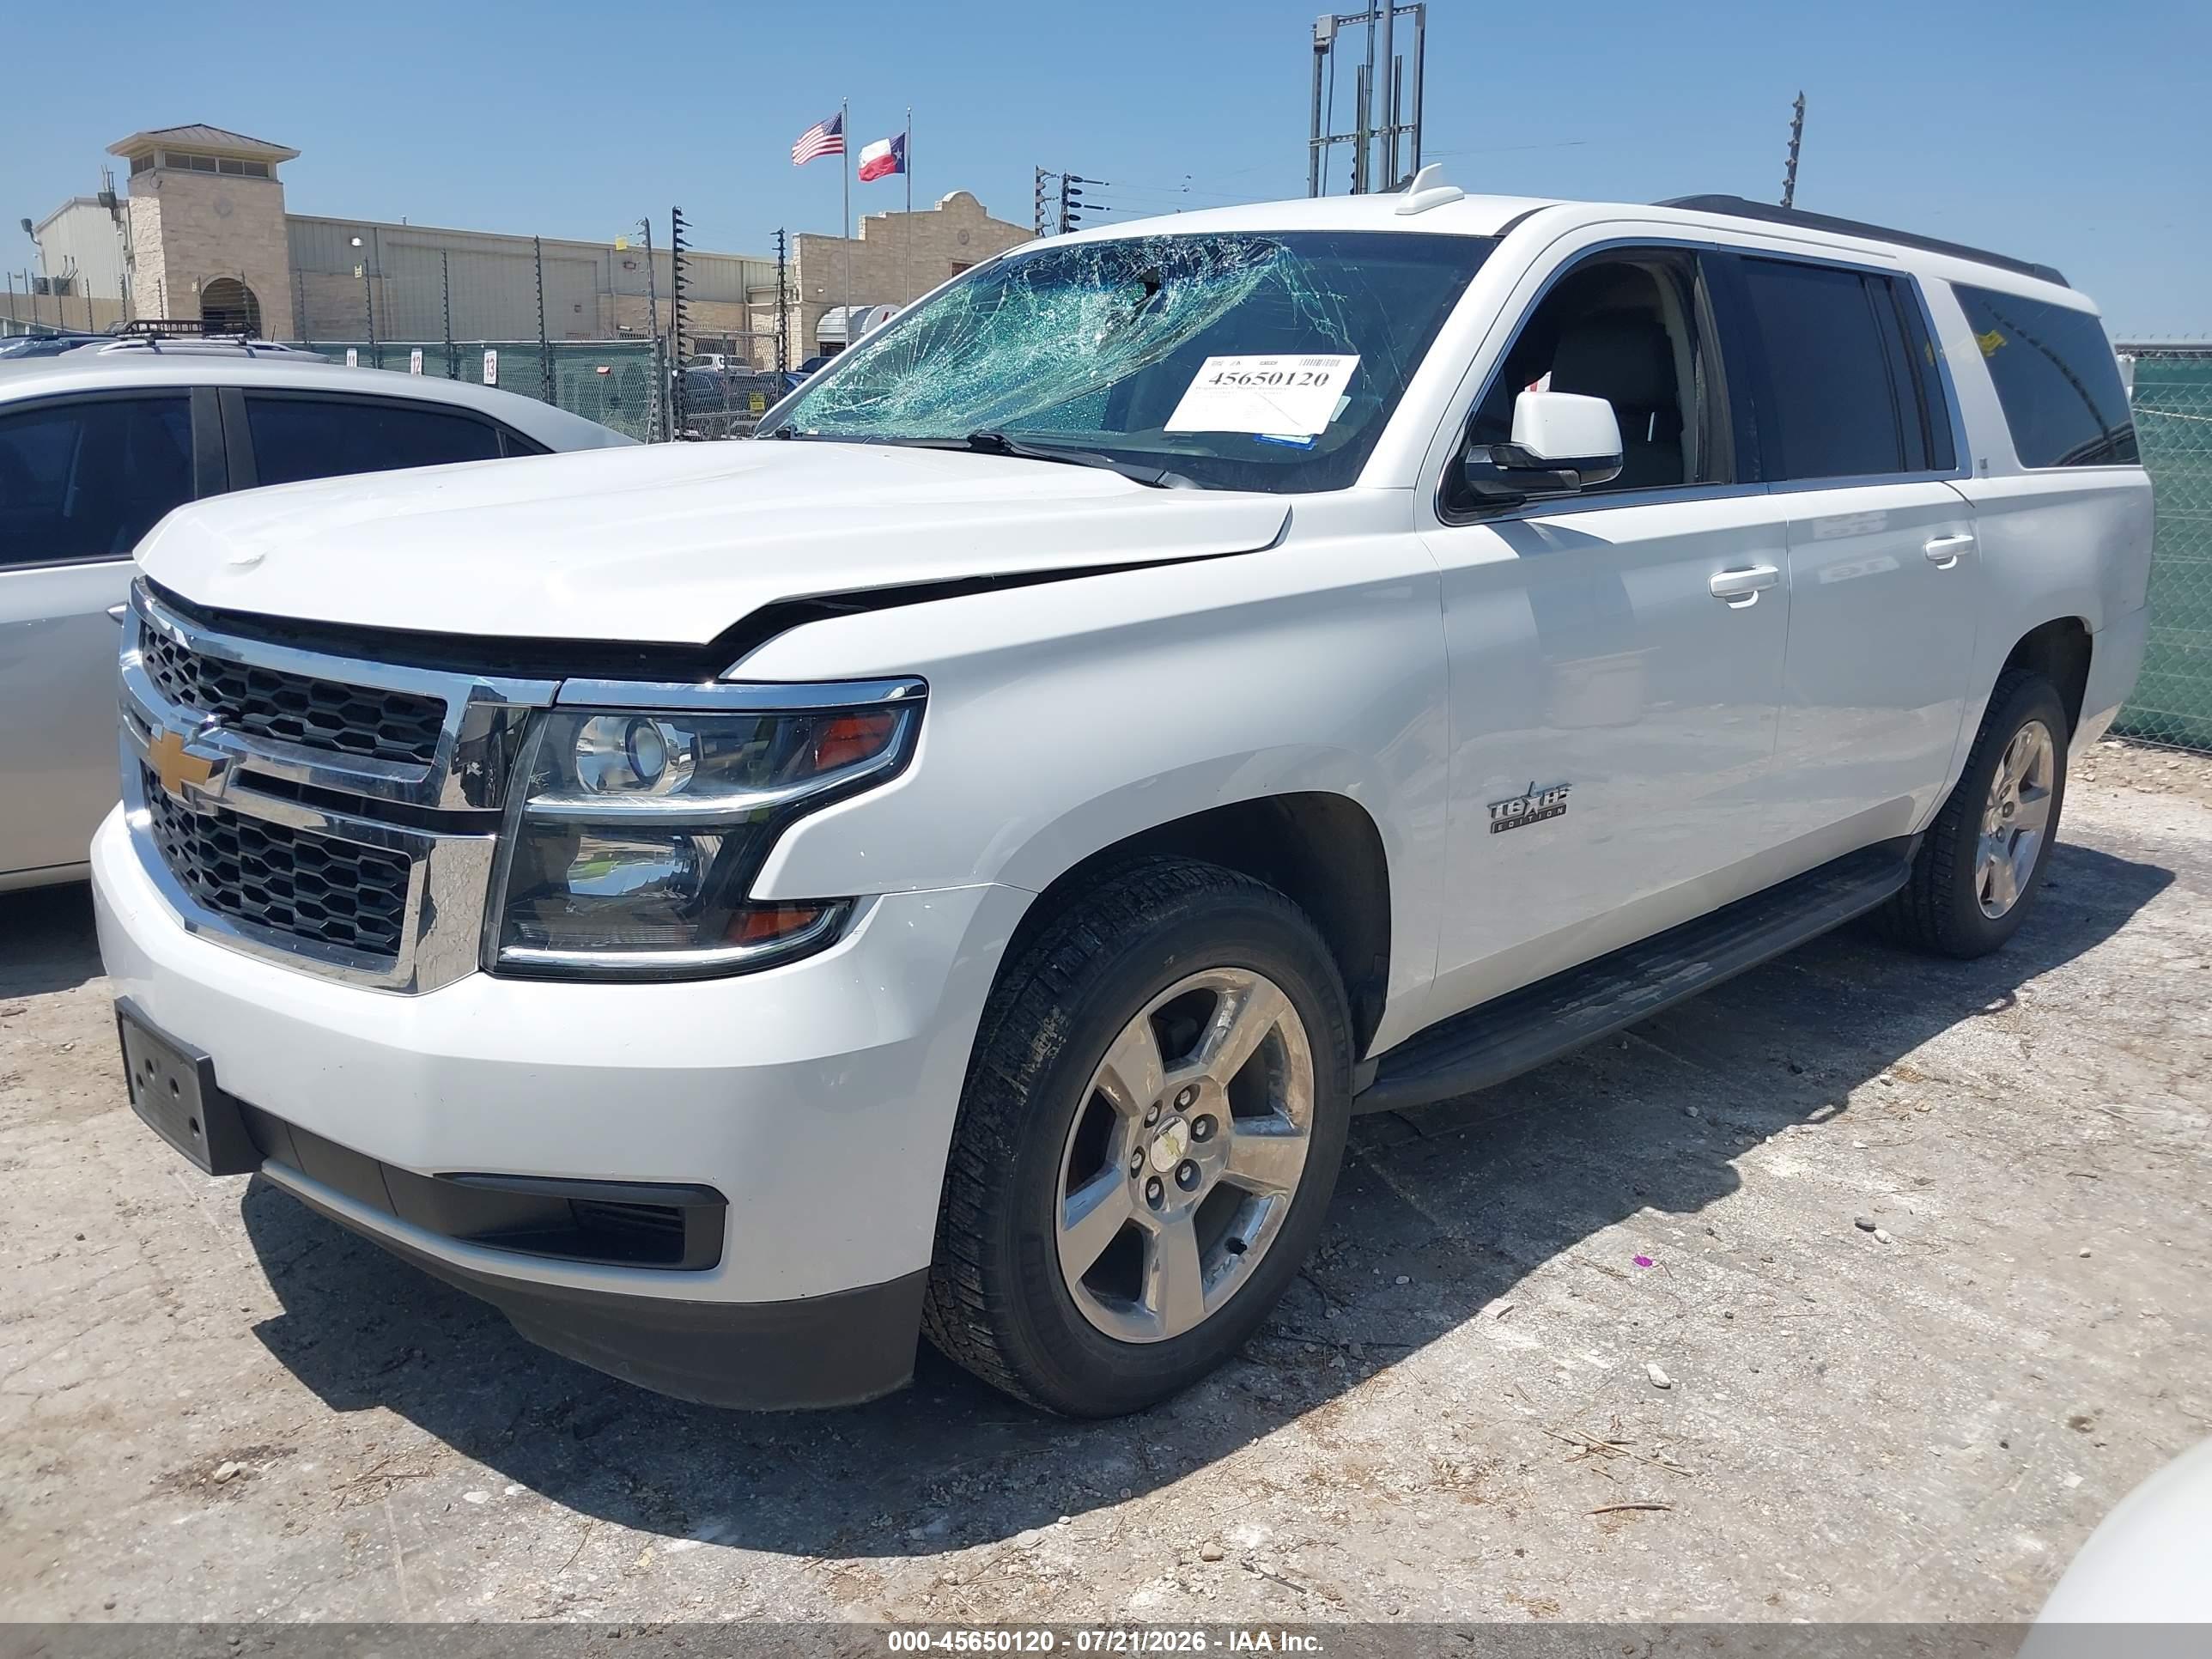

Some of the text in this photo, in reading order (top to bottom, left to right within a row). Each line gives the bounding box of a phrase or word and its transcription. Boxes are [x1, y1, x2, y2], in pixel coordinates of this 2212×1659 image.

[412, 356, 421, 375] 12
[486, 357, 495, 378] 13
[1208, 371, 1330, 388] 45650120
[1497, 806, 1564, 831] EDITION
